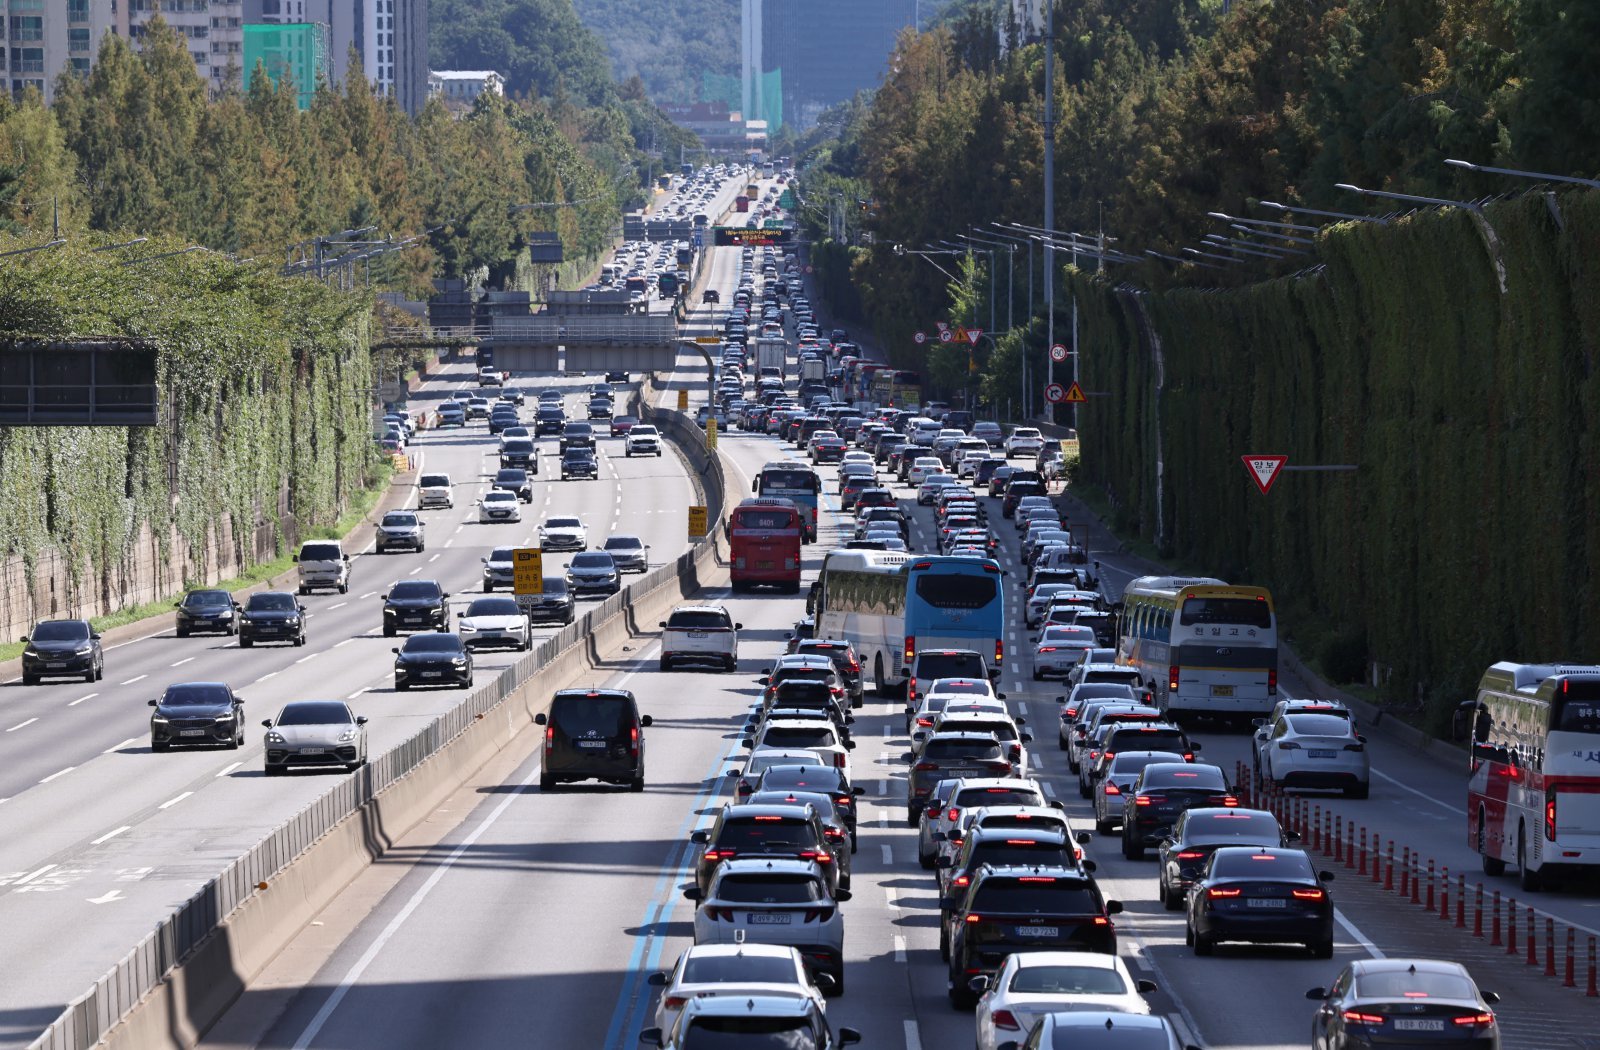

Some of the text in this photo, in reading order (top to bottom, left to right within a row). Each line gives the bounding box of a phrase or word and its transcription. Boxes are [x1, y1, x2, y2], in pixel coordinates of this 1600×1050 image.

[1053, 349, 1064, 358] 80
[1254, 461, 1275, 470] 양보
[519, 596, 539, 604] 500m
